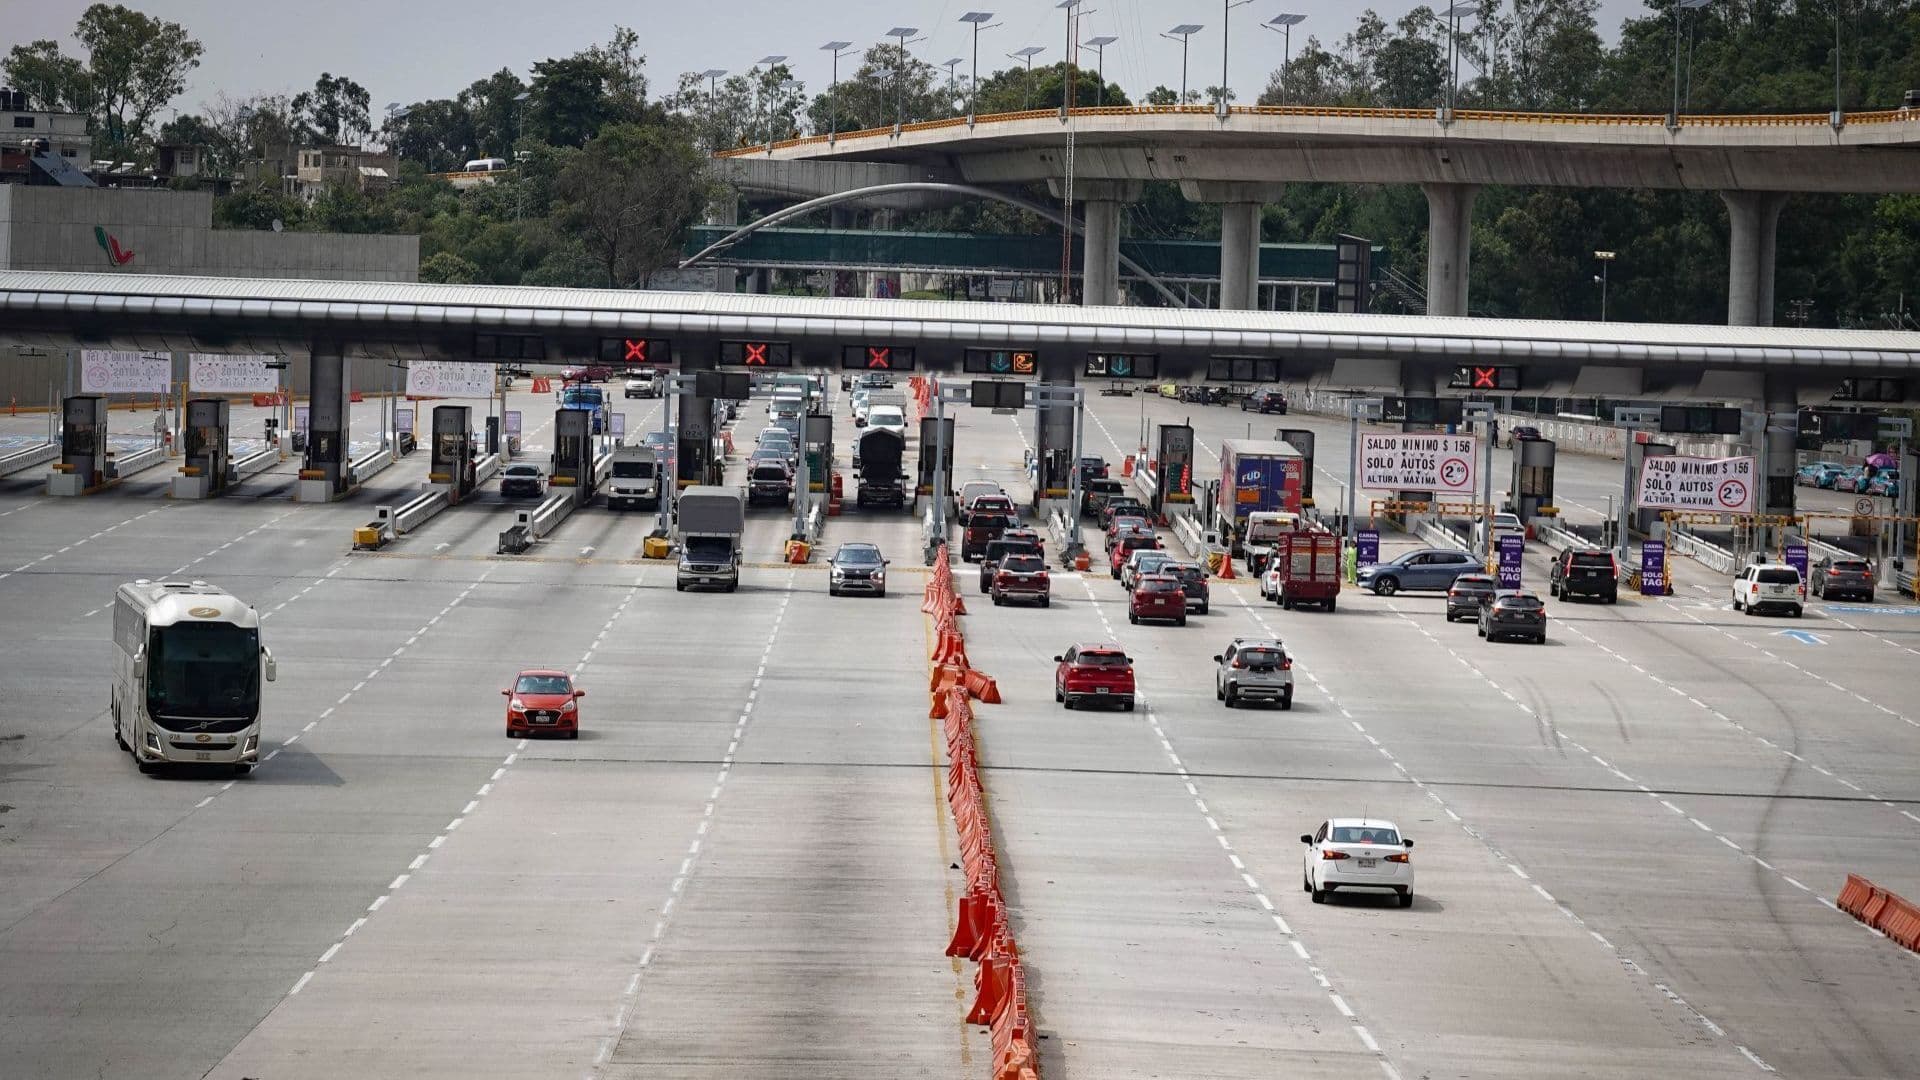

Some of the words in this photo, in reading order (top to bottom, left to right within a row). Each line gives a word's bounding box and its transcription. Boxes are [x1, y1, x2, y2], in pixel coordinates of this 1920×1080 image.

[1368, 439, 1396, 450] SALDO
[1402, 439, 1438, 451] MINIMO
[1443, 440, 1448, 451] $
[1455, 440, 1470, 453] 156
[1367, 458, 1393, 468] SOLO
[1401, 459, 1435, 470] AUTOS
[1649, 460, 1676, 473] SALDO
[1682, 462, 1717, 474] MINIMO
[1722, 462, 1728, 474] $
[1734, 462, 1749, 474] 156
[1242, 470, 1260, 483] FUD
[1445, 466, 1454, 478] 2
[1368, 475, 1398, 484] ALTURA
[1404, 476, 1436, 484] MAXIMA
[1646, 478, 1671, 490] SOLO
[1679, 482, 1713, 492] AUTOS
[1723, 488, 1732, 499] 2
[1644, 495, 1675, 504] ALTURA
[1681, 497, 1713, 506] MAXIMA
[1500, 573, 1520, 581] TAG
